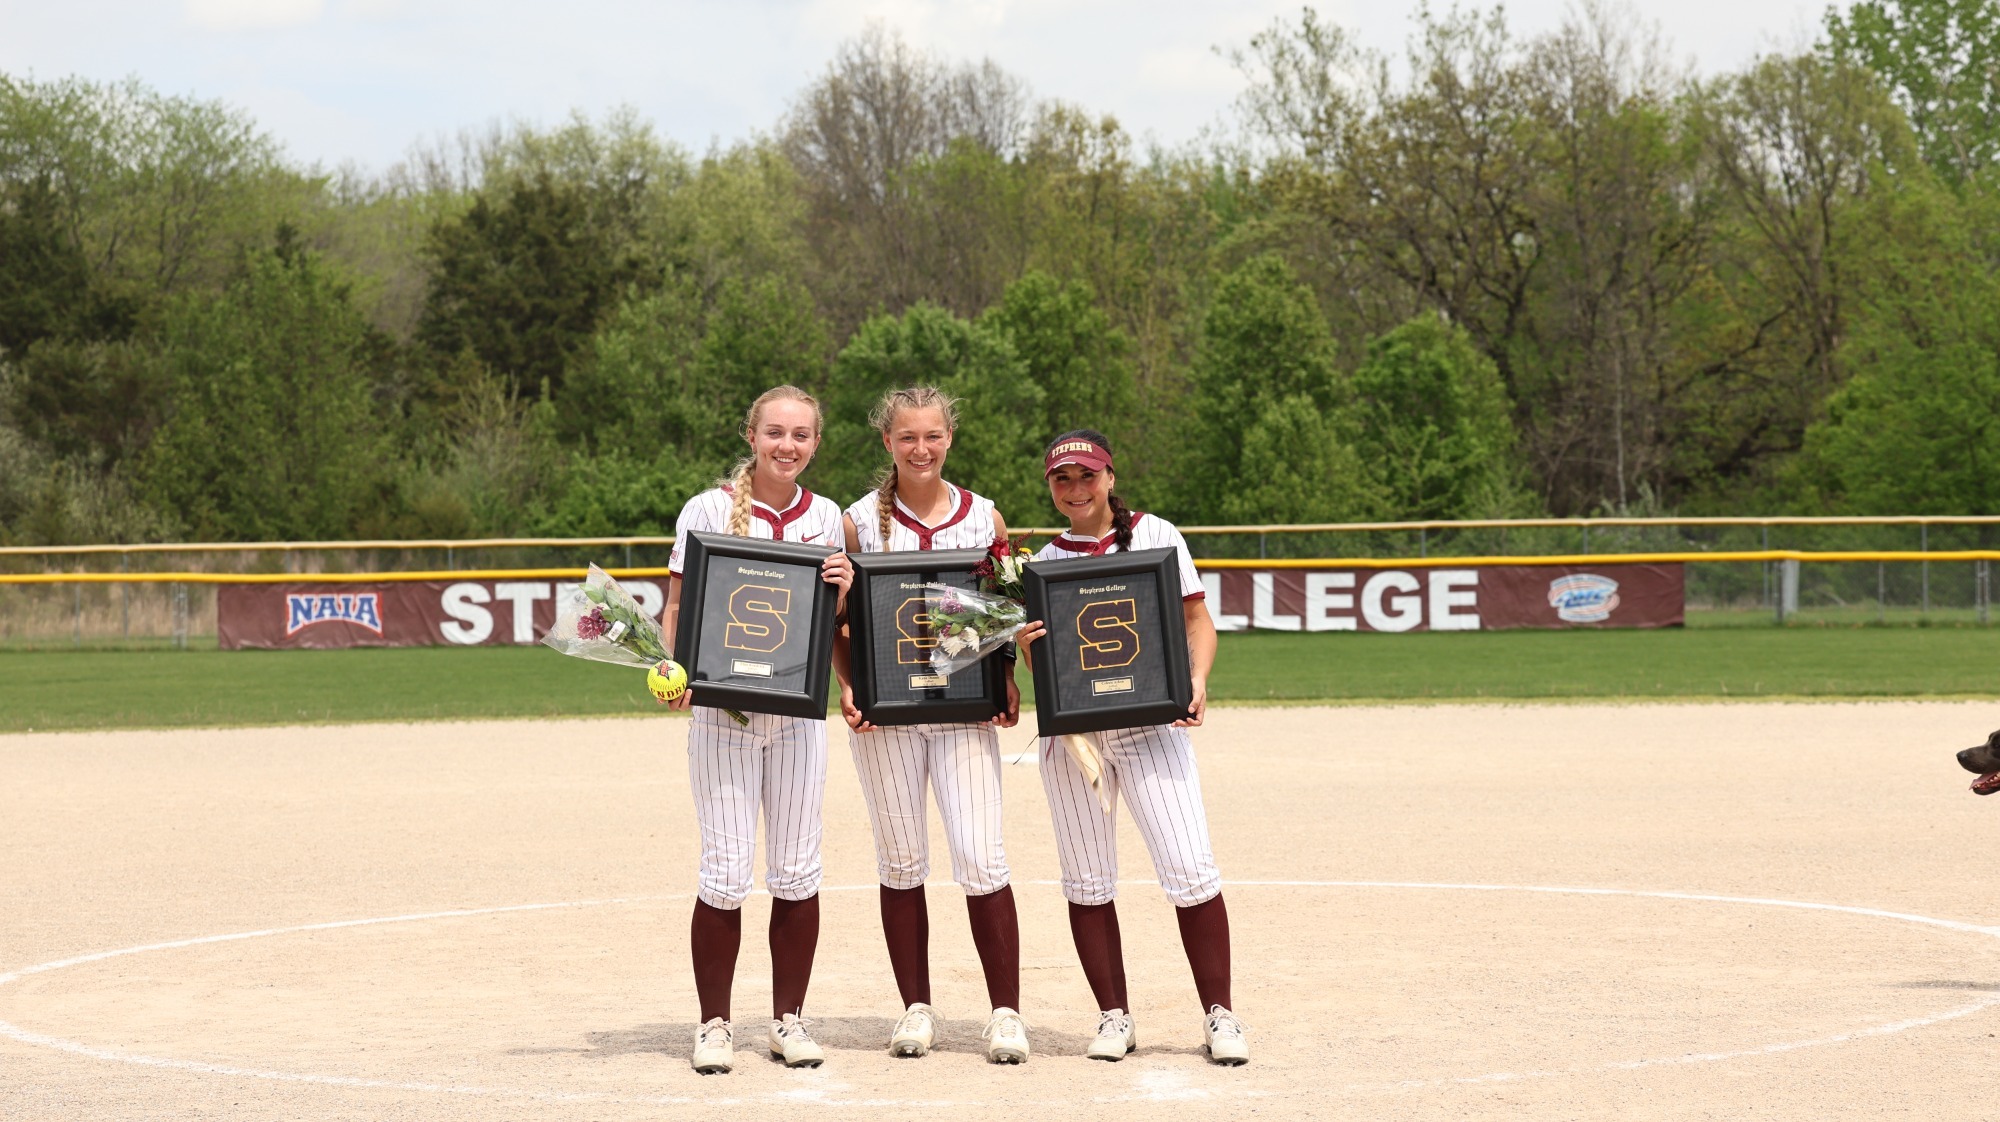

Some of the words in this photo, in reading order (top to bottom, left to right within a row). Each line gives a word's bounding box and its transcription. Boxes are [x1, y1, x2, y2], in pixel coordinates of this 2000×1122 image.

[1051, 442, 1093, 458] STEPHENS
[737, 566, 764, 576] Stephens
[764, 570, 786, 579] College
[900, 582, 926, 590] Stephens
[1079, 587, 1105, 595] Stephens
[1105, 584, 1127, 592] College
[287, 595, 382, 633] NAIA
[724, 583, 791, 653] S
[1076, 598, 1140, 671] S
